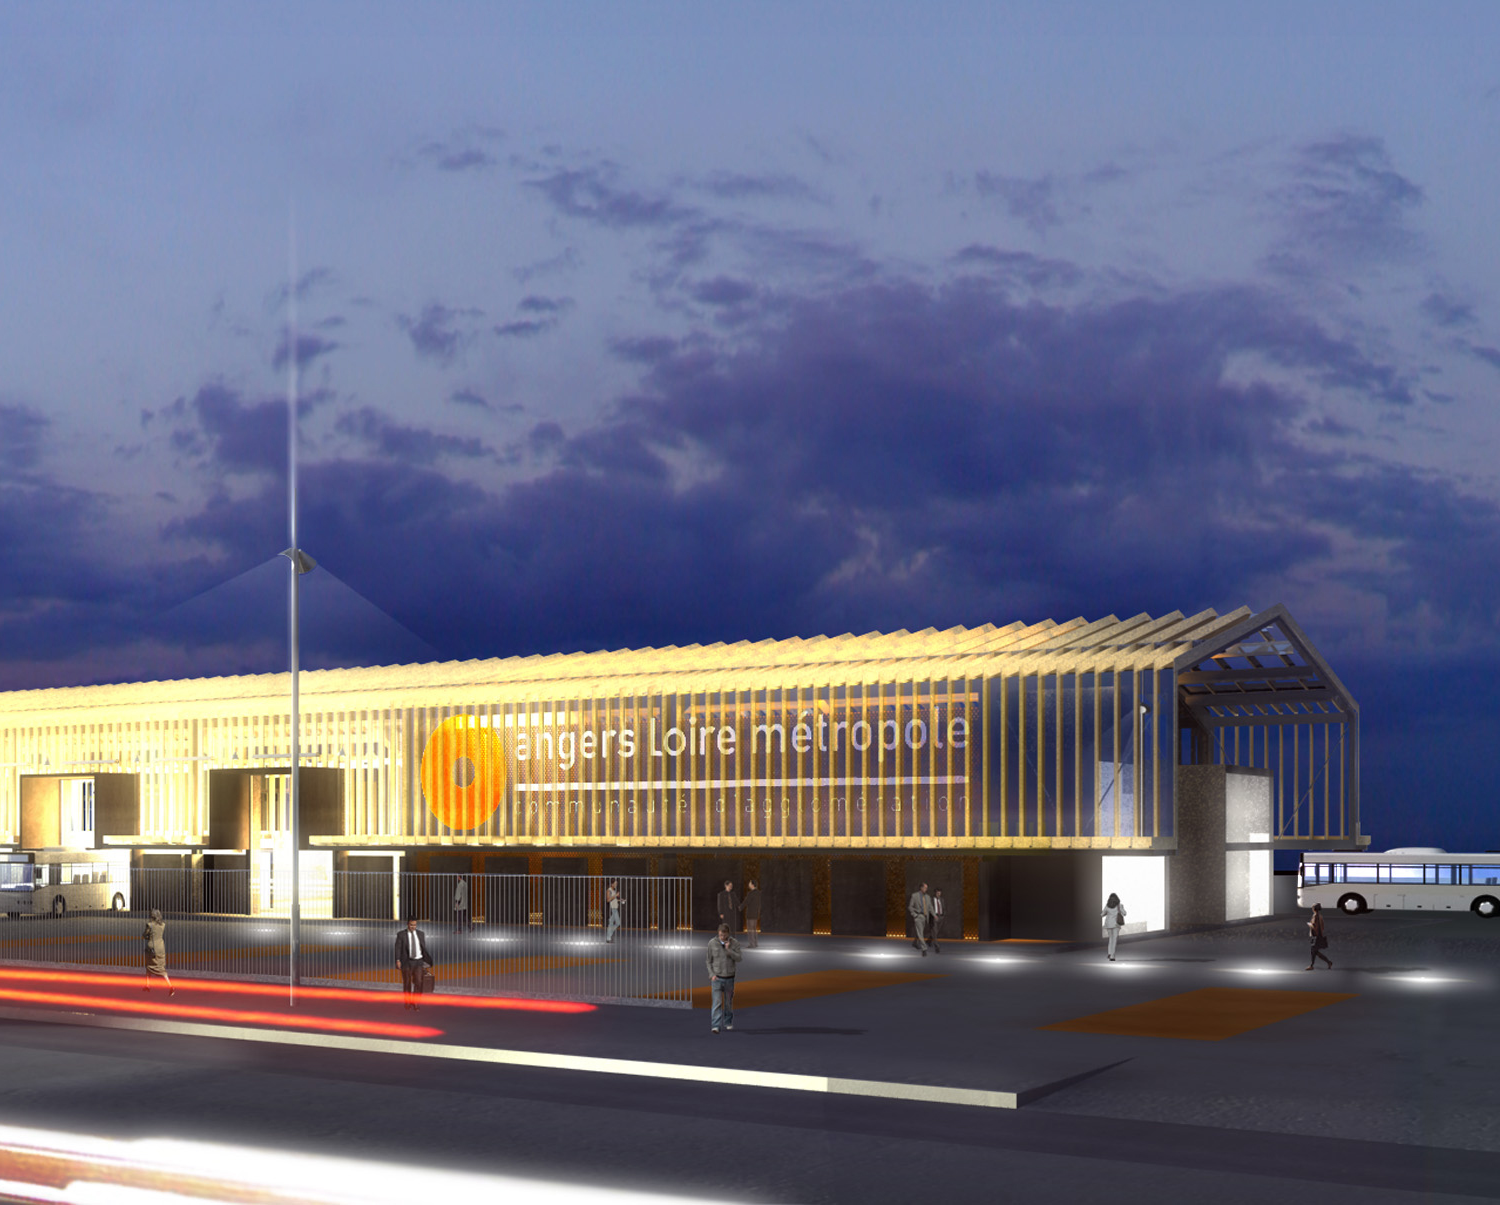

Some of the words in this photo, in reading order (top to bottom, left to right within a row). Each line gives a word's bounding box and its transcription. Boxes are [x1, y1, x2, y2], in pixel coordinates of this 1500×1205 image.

[515, 728, 636, 771] angers
[650, 716, 736, 757] Loire
[751, 705, 970, 763] métropole
